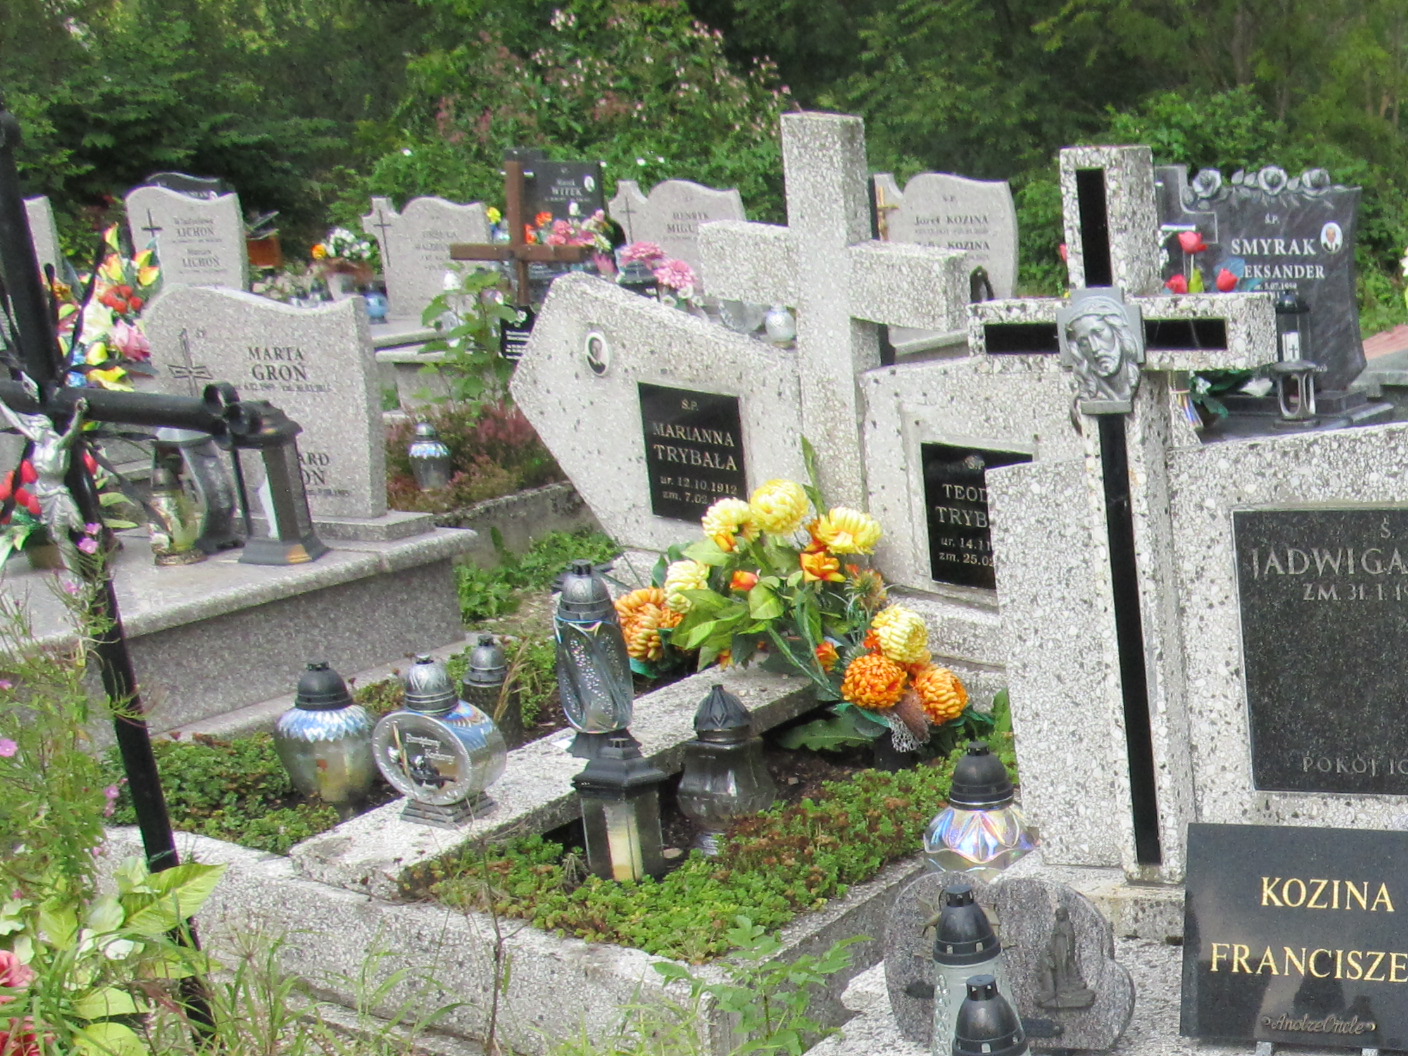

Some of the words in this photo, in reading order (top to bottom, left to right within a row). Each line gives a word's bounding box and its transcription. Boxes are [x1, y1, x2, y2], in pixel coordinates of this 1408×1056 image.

[946, 215, 988, 225] KOZINA
[1231, 238, 1317, 256] SMYRAK
[1244, 265, 1326, 279] EKSANDER
[247, 347, 305, 361] MARTA
[653, 422, 735, 447] MARIANNA
[942, 484, 988, 503] TEOD
[935, 506, 988, 528] TRYB
[939, 552, 960, 562] zm.
[1251, 547, 1408, 580] JADWIGA
[1303, 754, 1377, 776] POKÓJ
[1261, 876, 1395, 912] KOZINA
